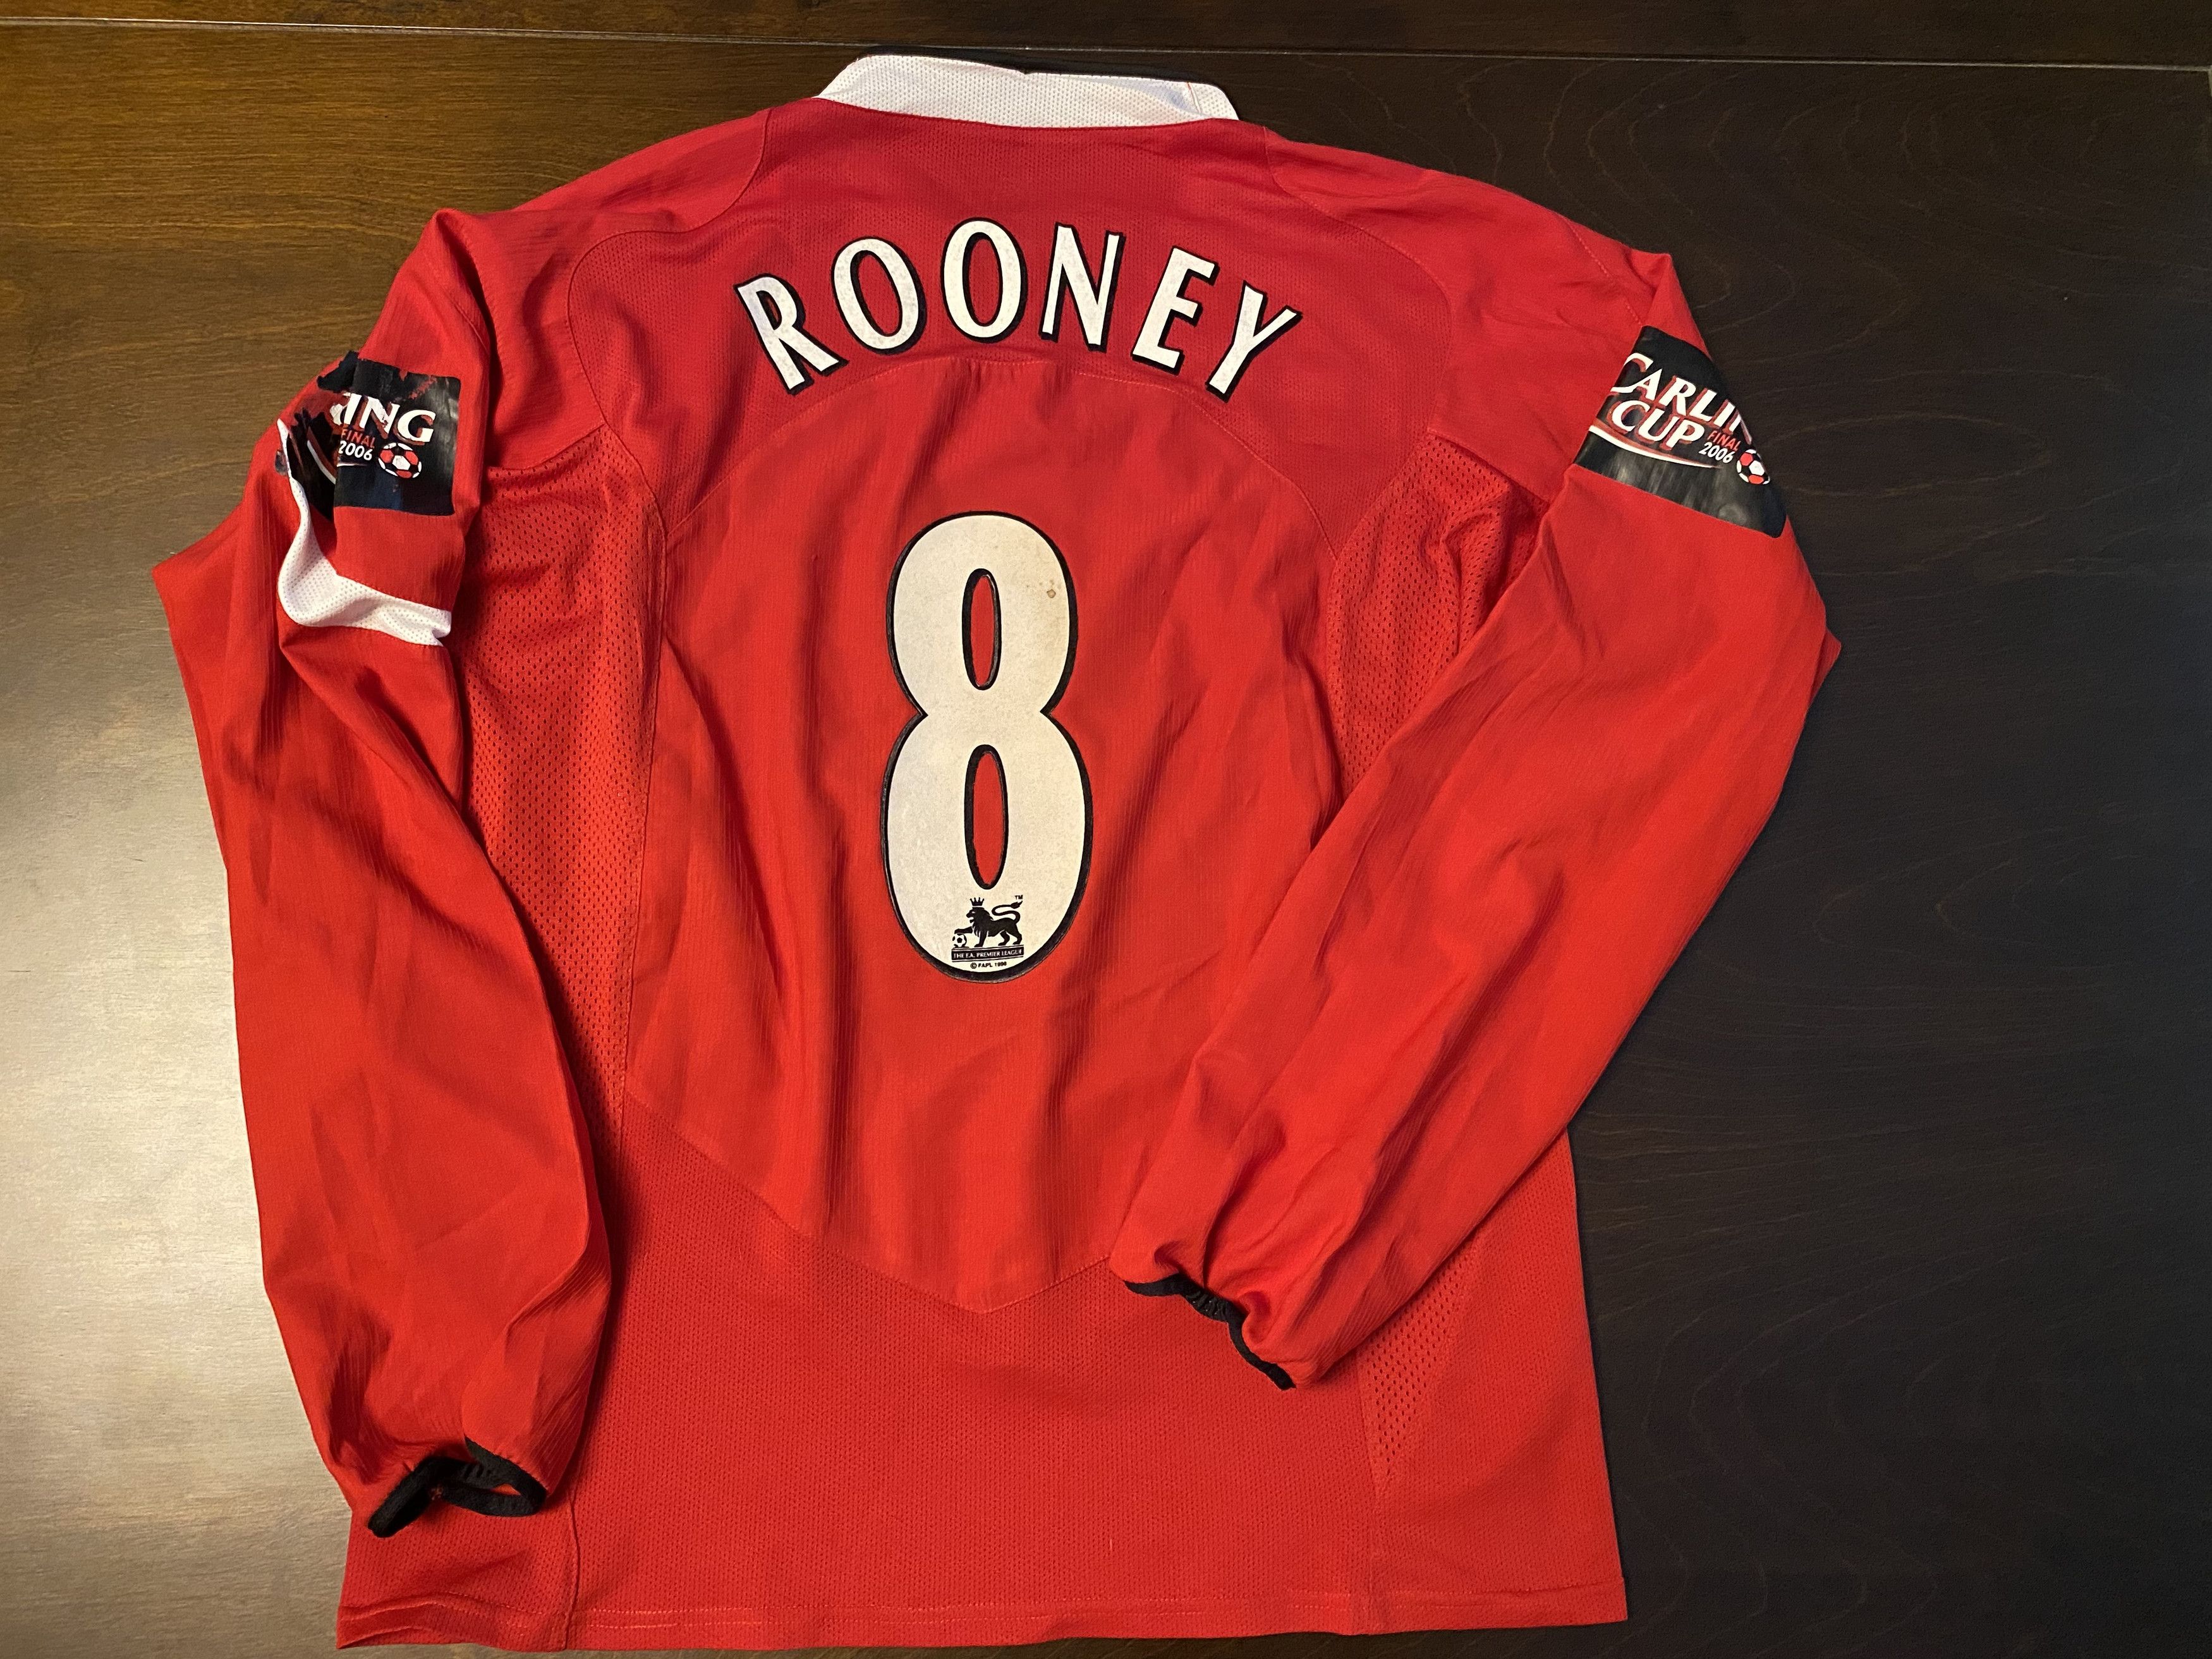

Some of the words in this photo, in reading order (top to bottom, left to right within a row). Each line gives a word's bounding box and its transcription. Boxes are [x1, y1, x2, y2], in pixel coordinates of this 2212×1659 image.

[736, 219, 1302, 402] ROONEY
[1607, 399, 1705, 451] CUP
[340, 429, 376, 449] FINAL
[1706, 429, 1742, 452] FINAL
[338, 441, 374, 461] 2006
[1698, 441, 1735, 464] 2006
[880, 511, 1093, 983] 8
